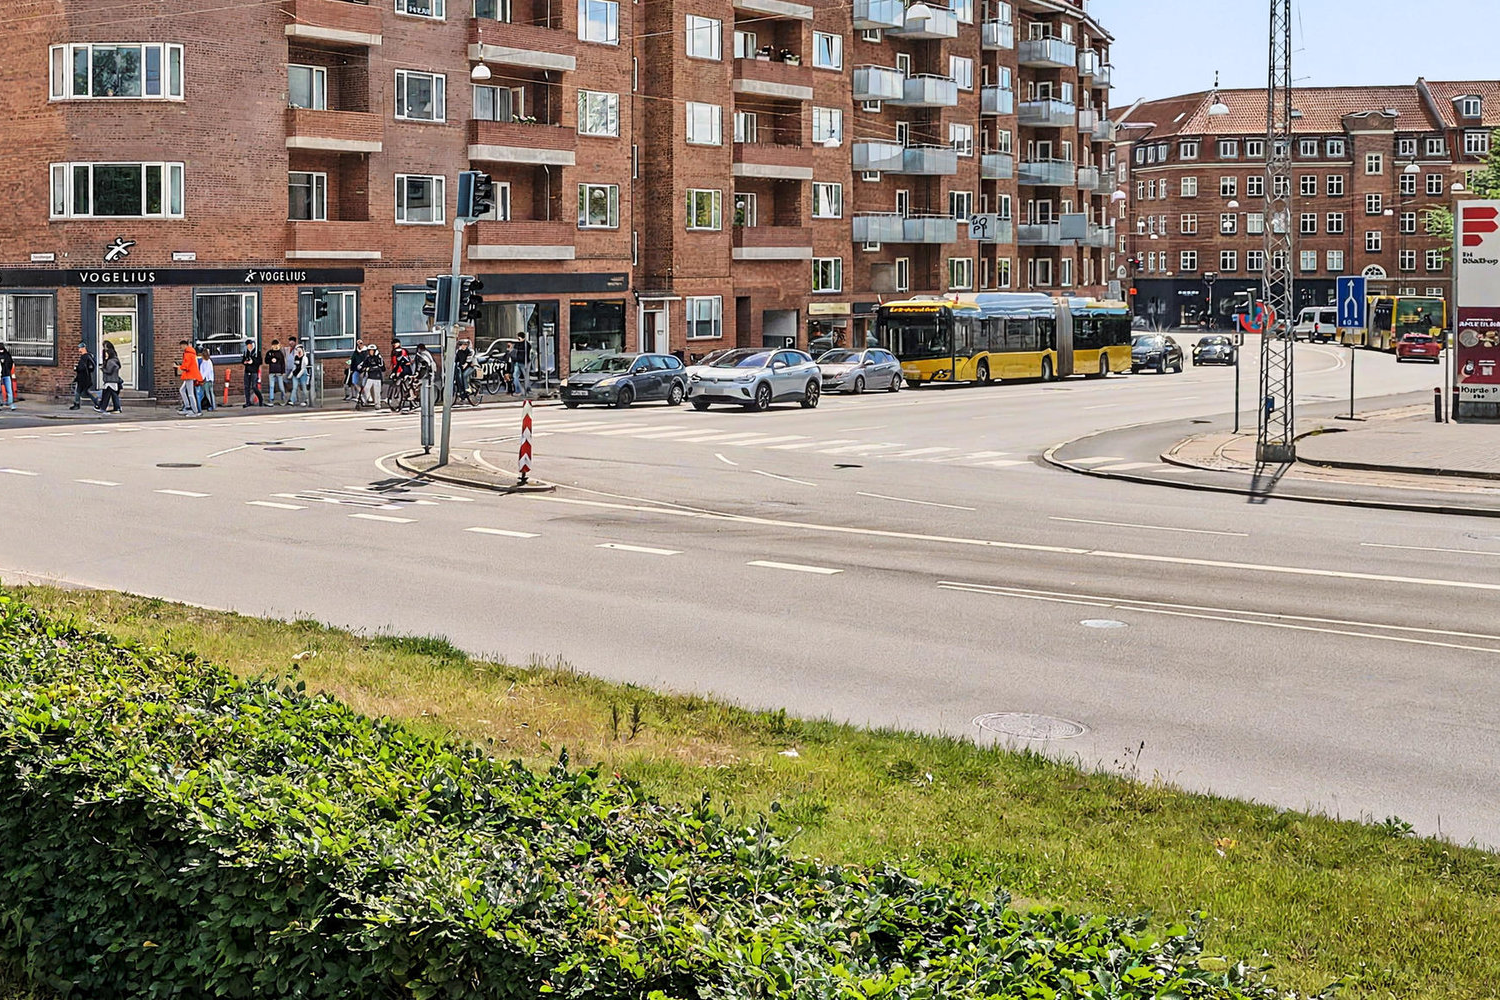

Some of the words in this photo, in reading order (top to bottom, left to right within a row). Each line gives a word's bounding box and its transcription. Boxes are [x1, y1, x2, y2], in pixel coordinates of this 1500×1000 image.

[79, 271, 156, 283] VOGELIUS
[259, 271, 307, 282] VOGELIUS
[785, 337, 794, 348] P
